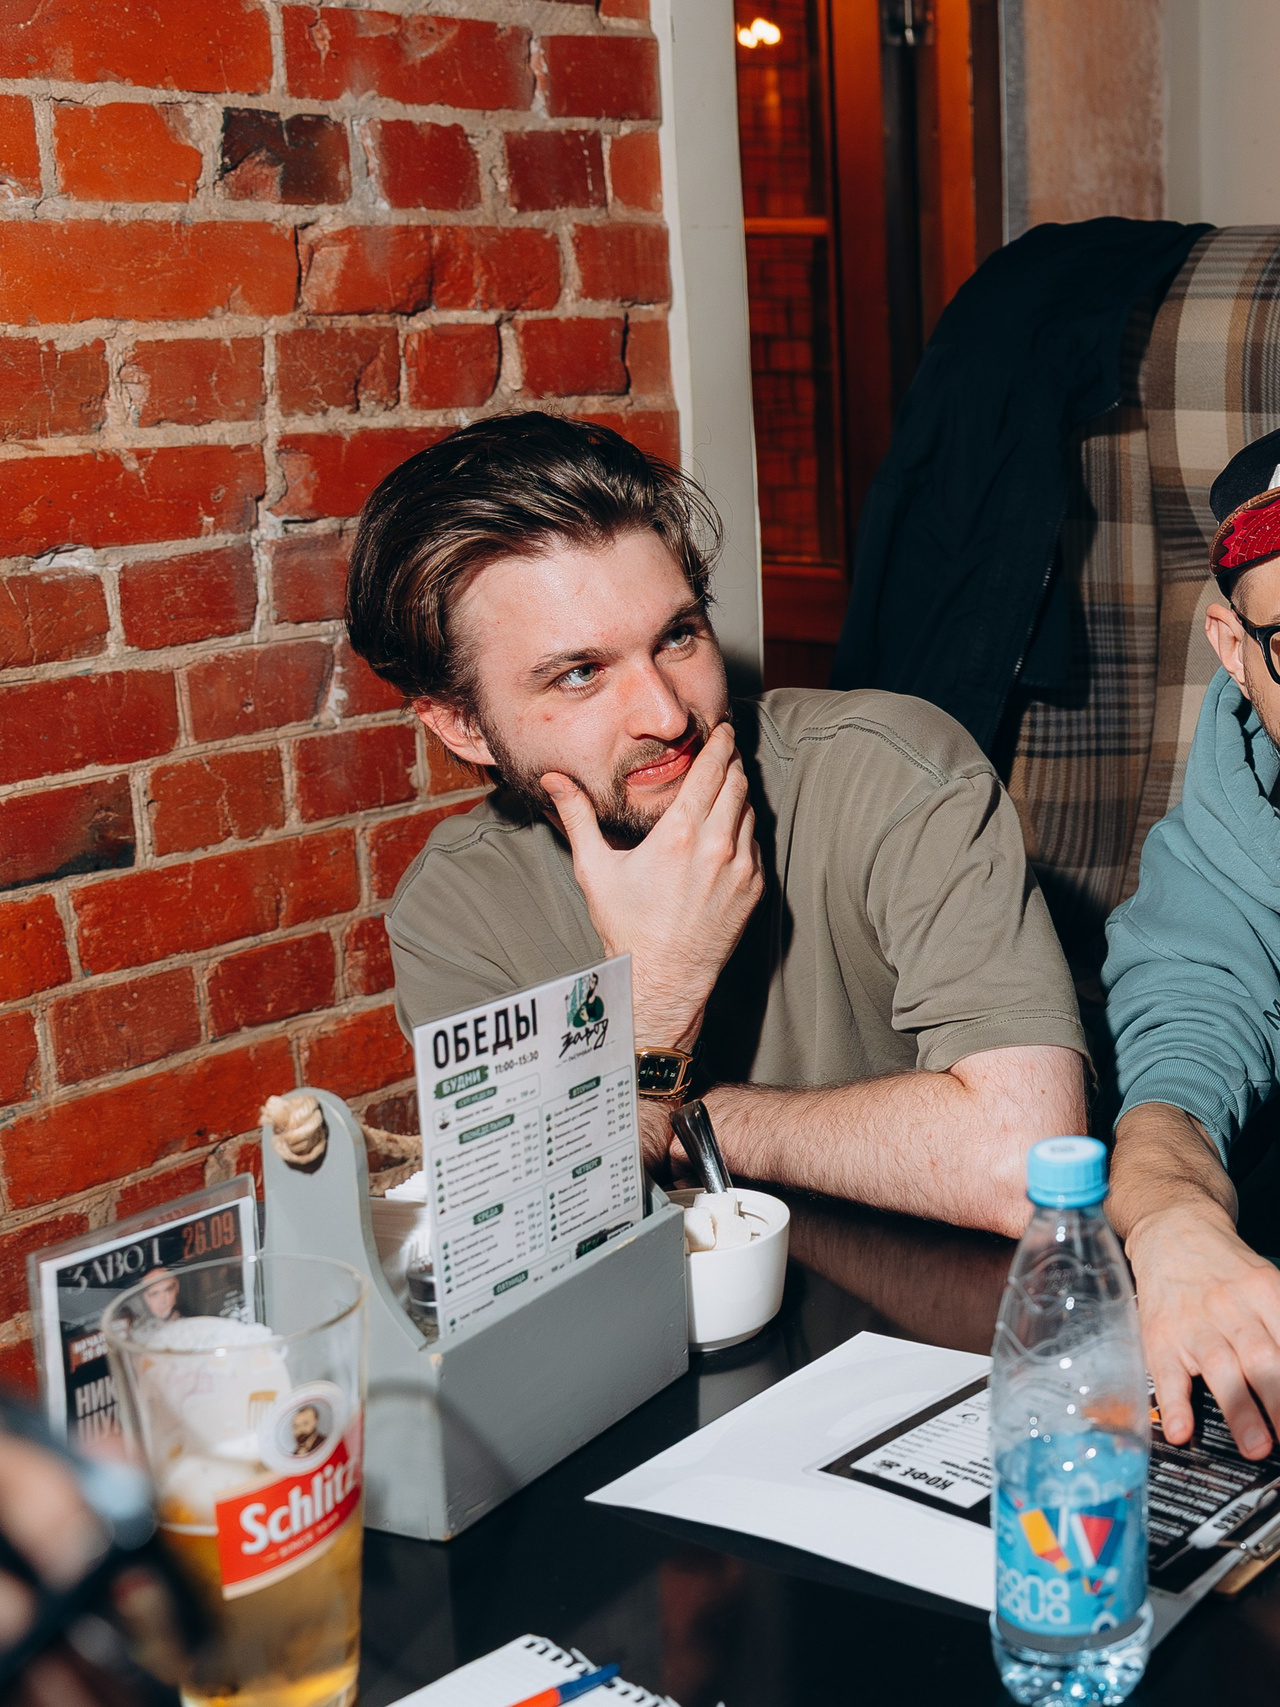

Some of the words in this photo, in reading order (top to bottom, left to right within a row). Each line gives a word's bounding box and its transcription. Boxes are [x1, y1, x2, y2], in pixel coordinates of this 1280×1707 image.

[432, 998, 538, 1069] ОБЕДЫ
[442, 1069, 481, 1095] БУДНИ
[181, 1211, 236, 1259] 26.09
[75, 1375, 117, 1418] НИК
